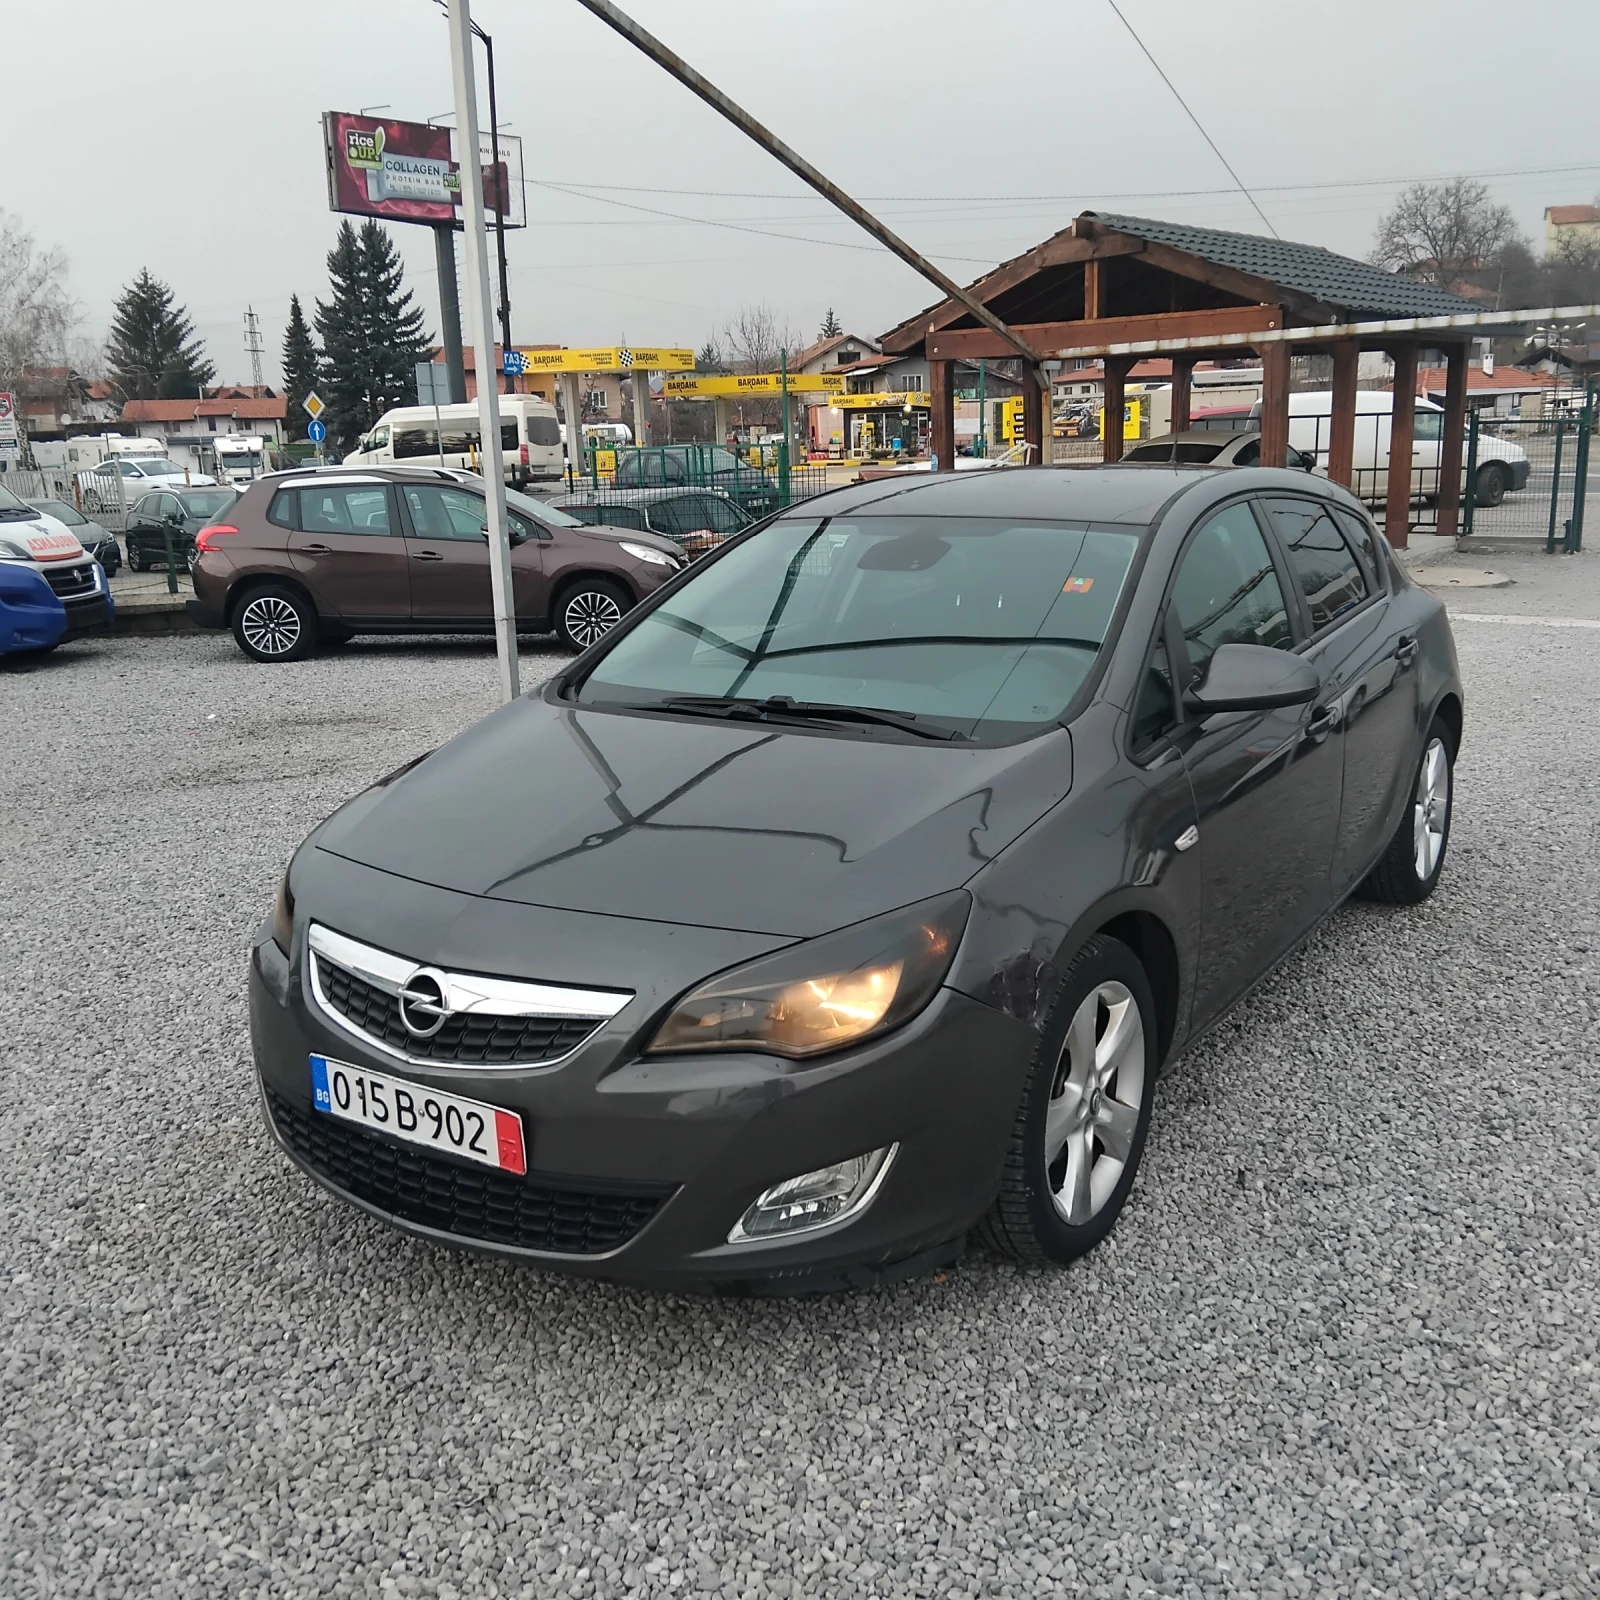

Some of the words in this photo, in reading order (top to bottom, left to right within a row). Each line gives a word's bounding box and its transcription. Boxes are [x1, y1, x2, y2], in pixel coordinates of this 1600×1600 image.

[349, 133, 374, 147] rice
[385, 160, 440, 175] COLLAGEN
[386, 174, 421, 184] PROTEIN
[425, 178, 441, 186] BAR
[503, 353, 520, 365] ГАЗ
[534, 355, 564, 367] BARDAHL
[635, 353, 659, 364] BARDAHL
[737, 377, 770, 389] BARDAHL
[775, 376, 797, 385] BAAHL
[822, 377, 842, 388] BARDAHL
[667, 381, 698, 393] BARDAHL
[832, 398, 855, 406] BARDAHL
[316, 1089, 329, 1103] BG
